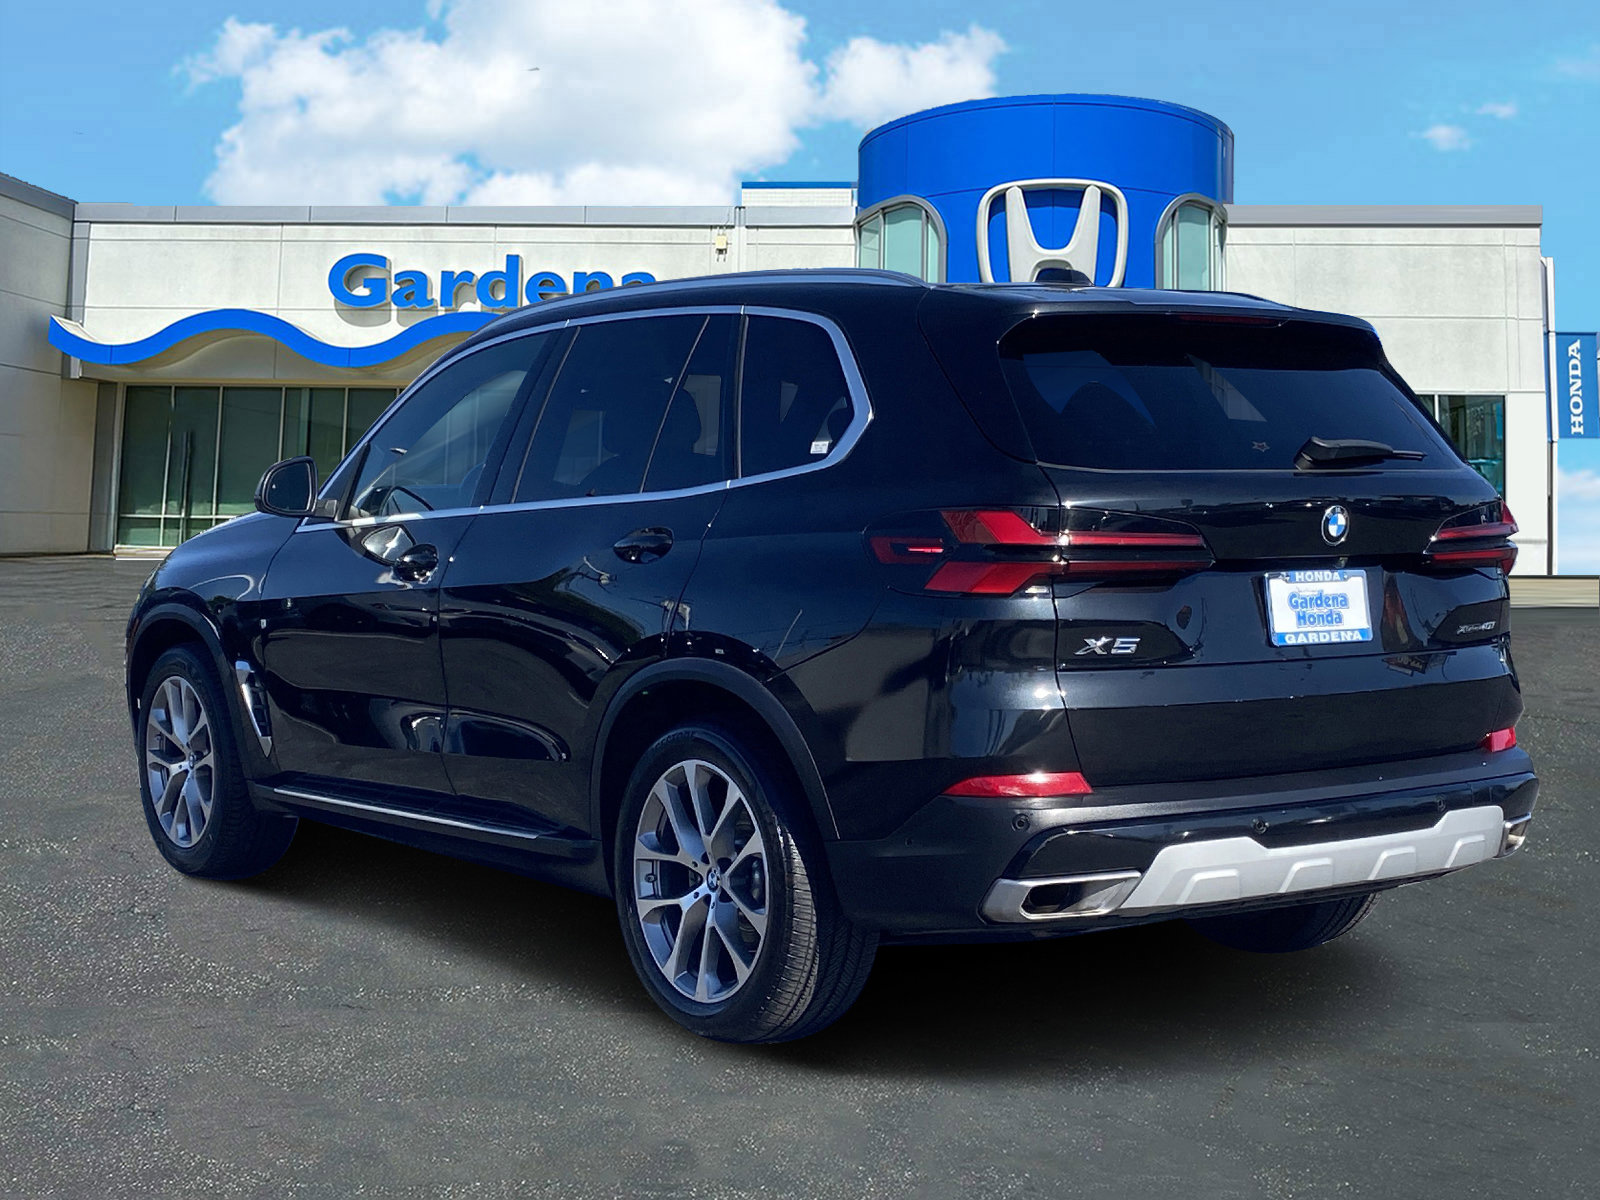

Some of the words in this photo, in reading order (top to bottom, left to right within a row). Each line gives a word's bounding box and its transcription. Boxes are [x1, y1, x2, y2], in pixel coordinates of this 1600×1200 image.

[1568, 338, 1584, 435] HONDA
[1295, 571, 1341, 582] HONDA
[1288, 589, 1348, 609] Gardena
[1297, 610, 1343, 626] Honda
[1074, 636, 1141, 655] X5
[1284, 630, 1363, 644] GARDENA
